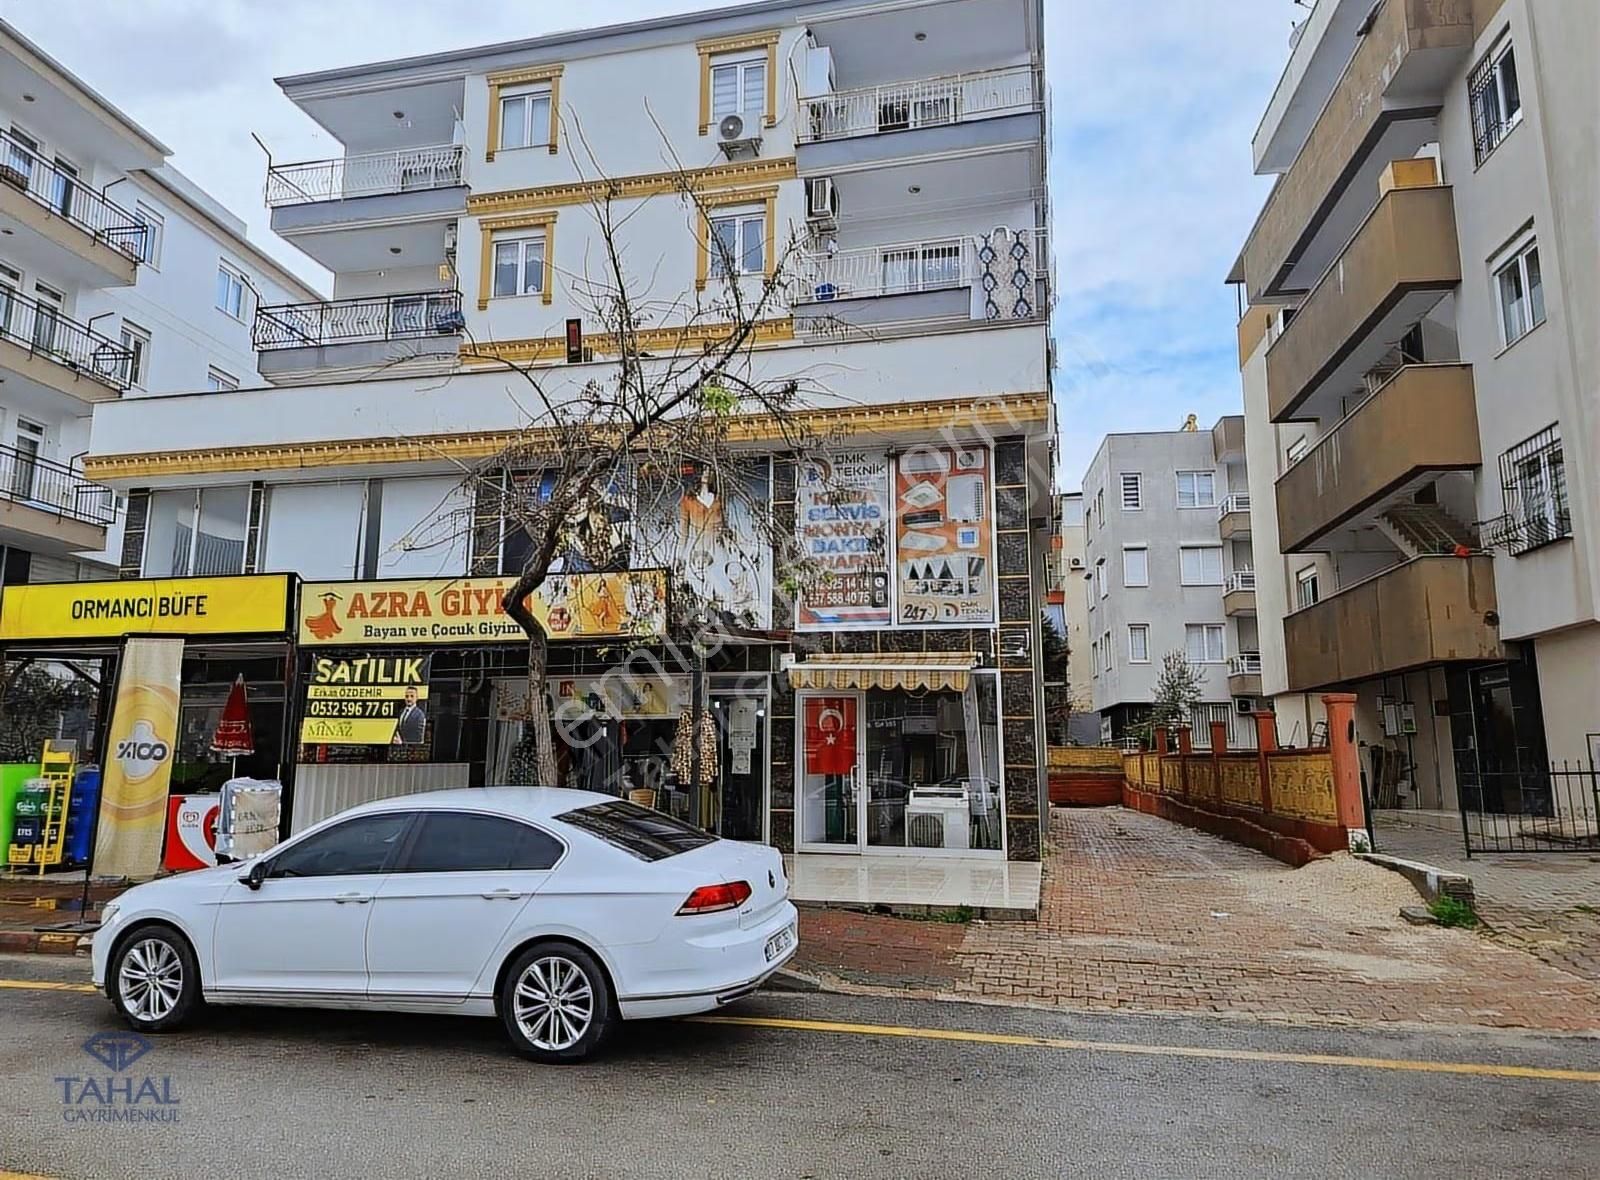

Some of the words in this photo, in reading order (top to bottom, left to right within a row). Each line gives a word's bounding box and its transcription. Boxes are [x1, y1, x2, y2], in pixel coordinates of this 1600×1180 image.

[836, 463, 885, 477] TEKNİK
[71, 597, 154, 619] ORMANCI
[158, 591, 208, 616] BÜFE
[346, 591, 432, 619] AZRA
[441, 582, 533, 617] GİYİ
[364, 624, 407, 640] Bayan
[411, 628, 427, 637] ve
[431, 623, 475, 639] Çocuk
[478, 622, 522, 637] Giyim
[315, 658, 424, 683] SATILIK
[313, 688, 337, 698] Erkan
[339, 686, 383, 698] ÖZDEMİR
[311, 701, 340, 716] 0532
[341, 701, 363, 716] 596
[365, 701, 380, 716] 77
[381, 701, 394, 716] 61
[117, 742, 168, 761] %100
